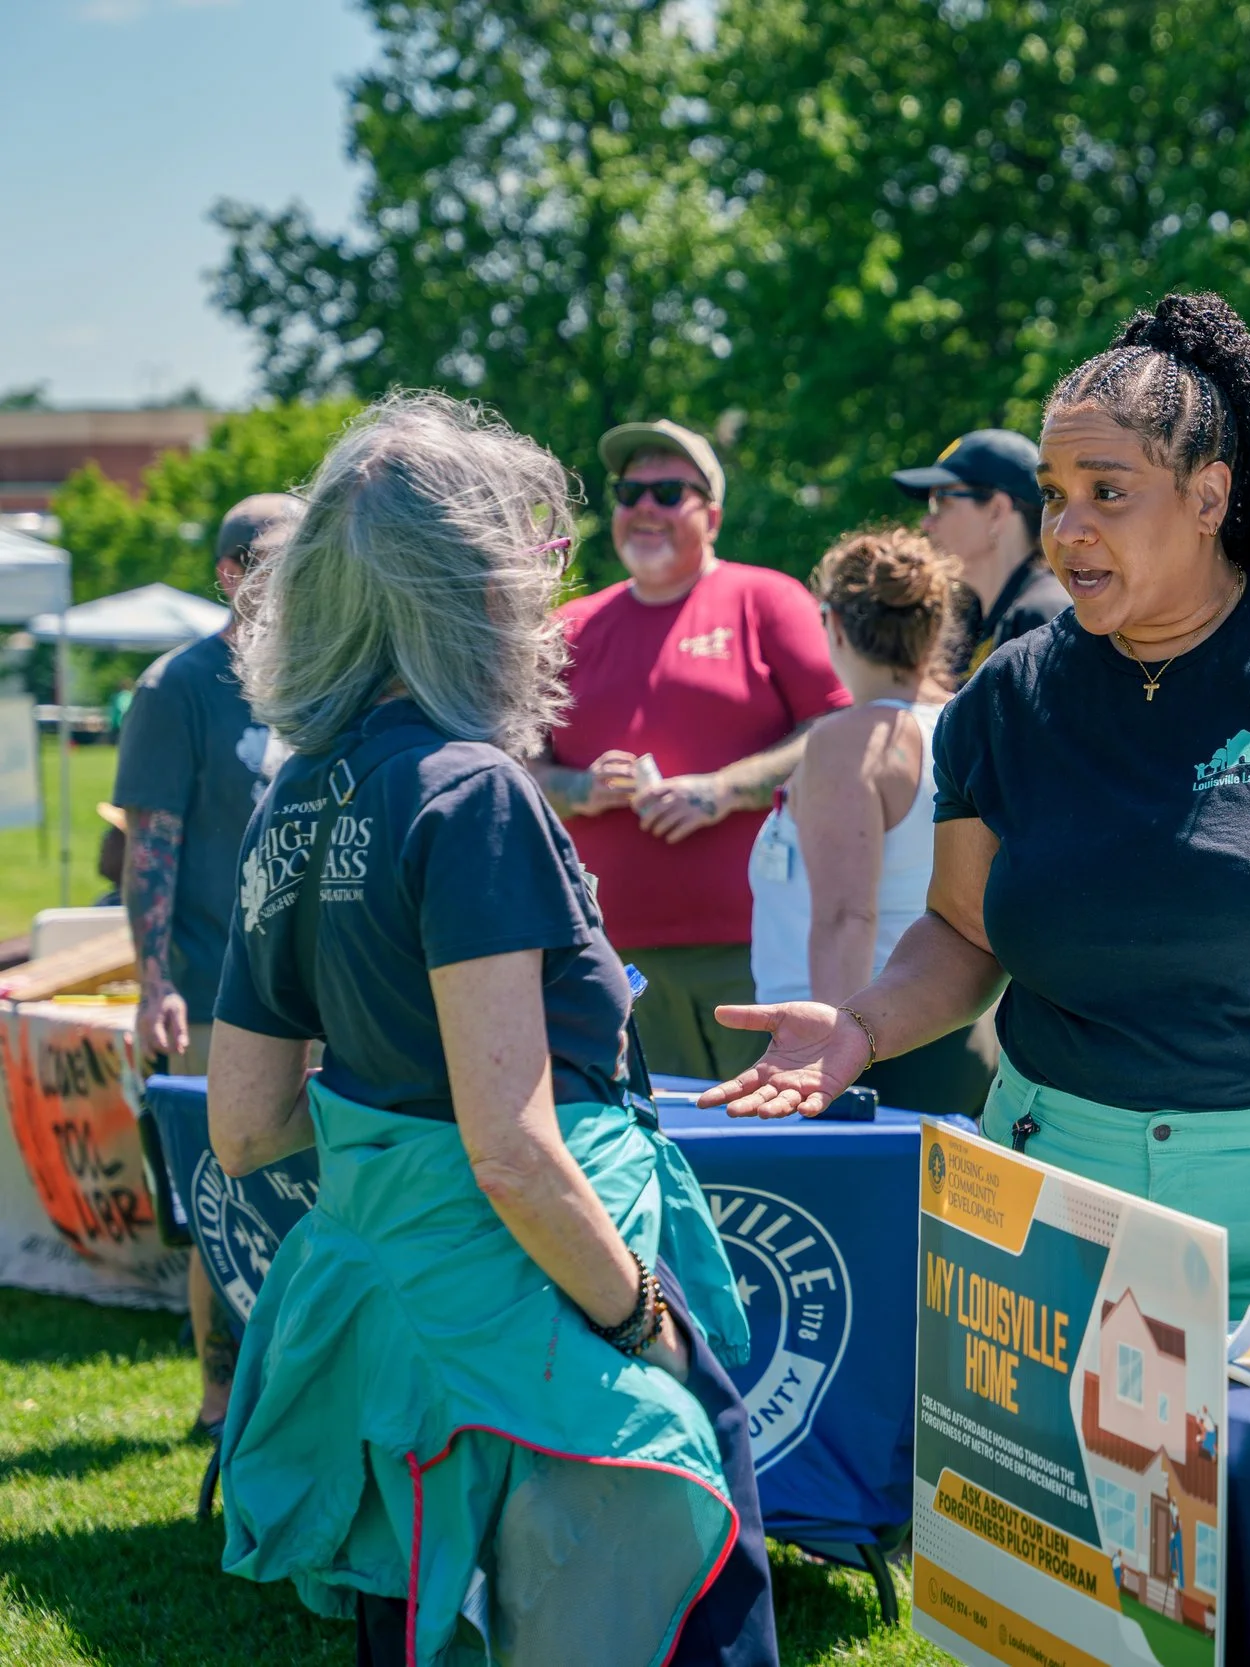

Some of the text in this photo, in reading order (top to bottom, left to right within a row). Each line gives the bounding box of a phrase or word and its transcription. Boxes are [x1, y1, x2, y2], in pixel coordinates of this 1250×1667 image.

[1192, 774, 1240, 792] Louisville
[258, 816, 373, 866] HIGHNDS
[266, 849, 369, 891] DOASS
[948, 1153, 984, 1181] HOUSING
[986, 1171, 1000, 1188] AND
[948, 1171, 997, 1206] COMMUNITY
[947, 1190, 1005, 1229] DEVELOPMENT
[710, 1194, 837, 1299] VILLE
[797, 1303, 825, 1342] 1778
[926, 1251, 1069, 1374] MY LOUISVILLE
[748, 1366, 802, 1439] UNTY
[965, 1332, 1019, 1415] HOME
[921, 1393, 1076, 1486] CREATING AFFORDABLE HOUSING THROUGH THE
[921, 1409, 1088, 1510] FORGIVENESS OF METRO CODE ENFORCEMENT LIENS
[938, 1490, 1097, 1595] FORGIVENESS PILOT PROGRAM
[961, 1483, 1070, 1558] ASK ABOUT OUR LIEN
